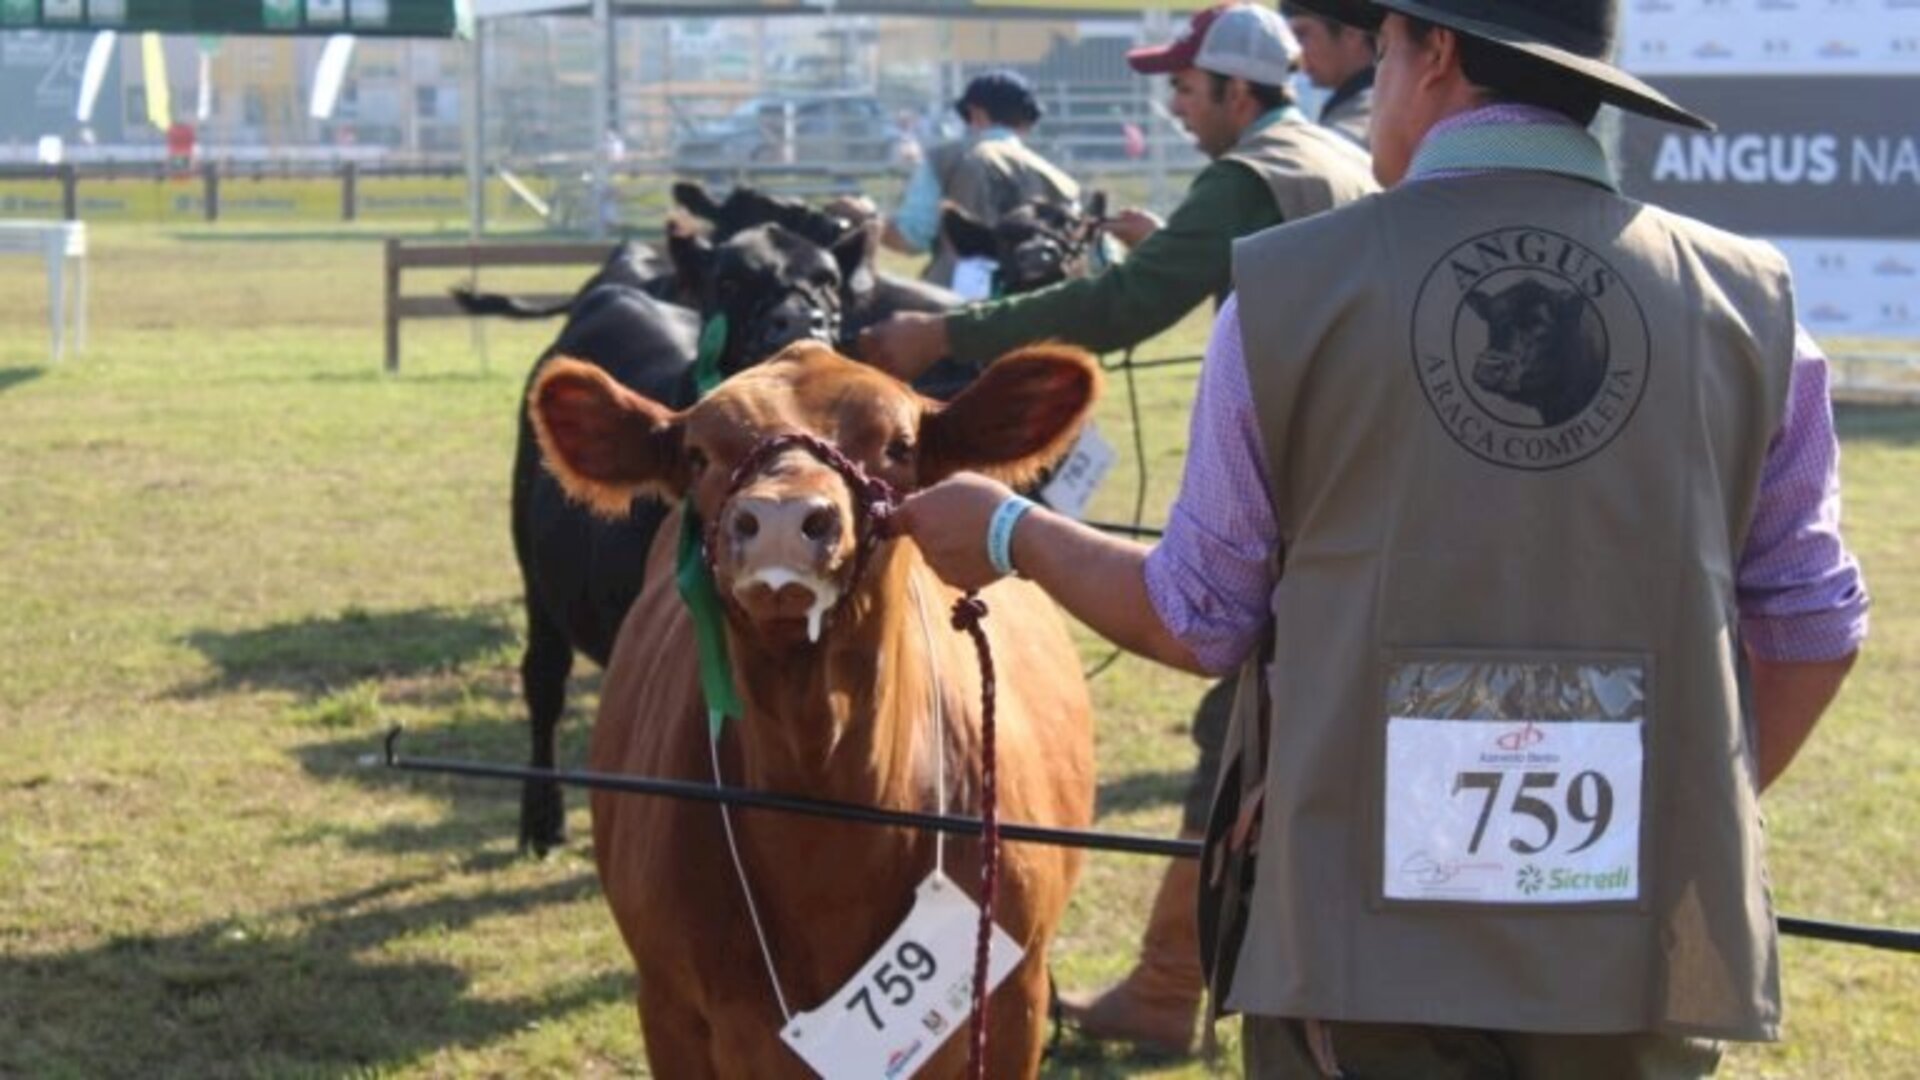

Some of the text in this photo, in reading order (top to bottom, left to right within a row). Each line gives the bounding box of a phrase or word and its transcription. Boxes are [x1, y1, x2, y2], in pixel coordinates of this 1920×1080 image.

[1654, 134, 1920, 183] ANGUS NA
[1450, 231, 1612, 299] ANGUS
[1503, 365, 1634, 460] COMPLETA
[1451, 769, 1615, 855] 759
[1549, 867, 1630, 892] Sicredi
[844, 940, 938, 1032] 759
